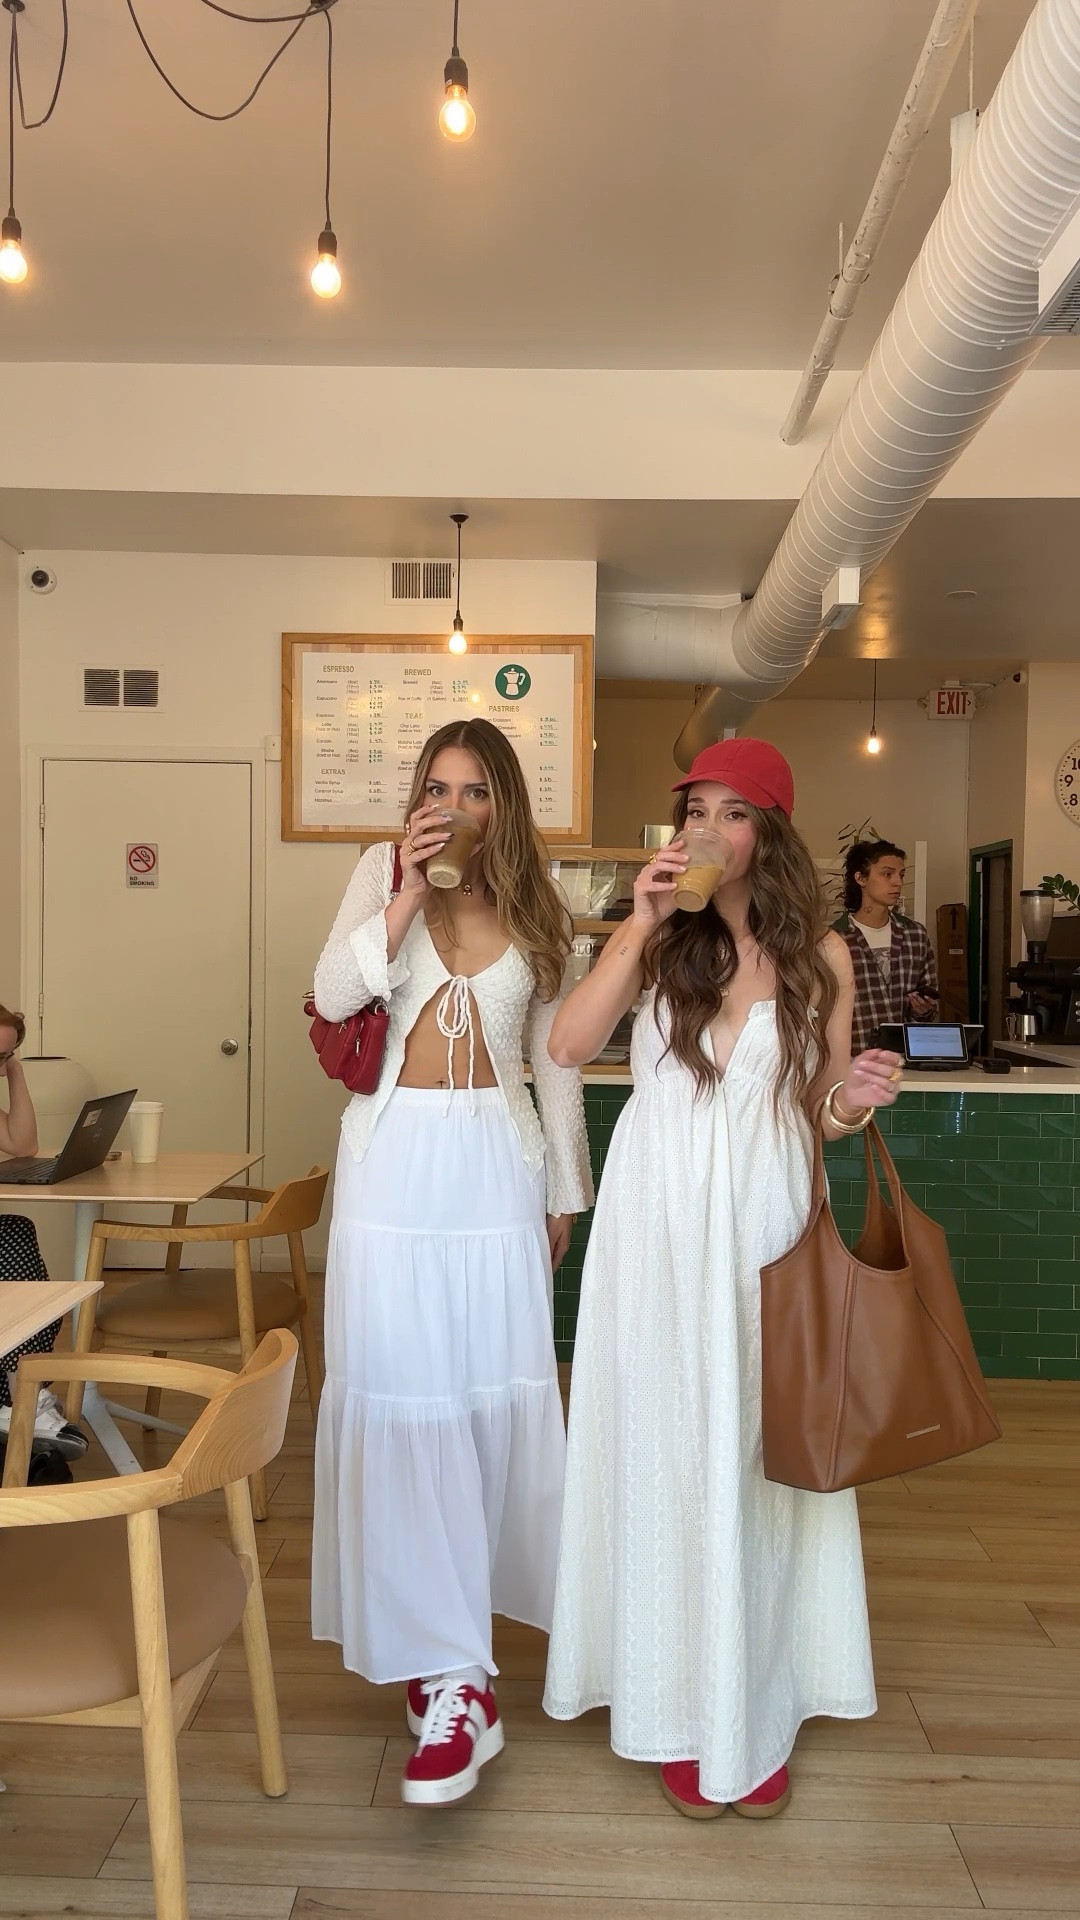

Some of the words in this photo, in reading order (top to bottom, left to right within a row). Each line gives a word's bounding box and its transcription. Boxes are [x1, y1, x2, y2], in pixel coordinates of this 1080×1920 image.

[937, 692, 968, 714] EXIT
[1064, 774, 1074, 787] 9
[1069, 794, 1078, 806] 8
